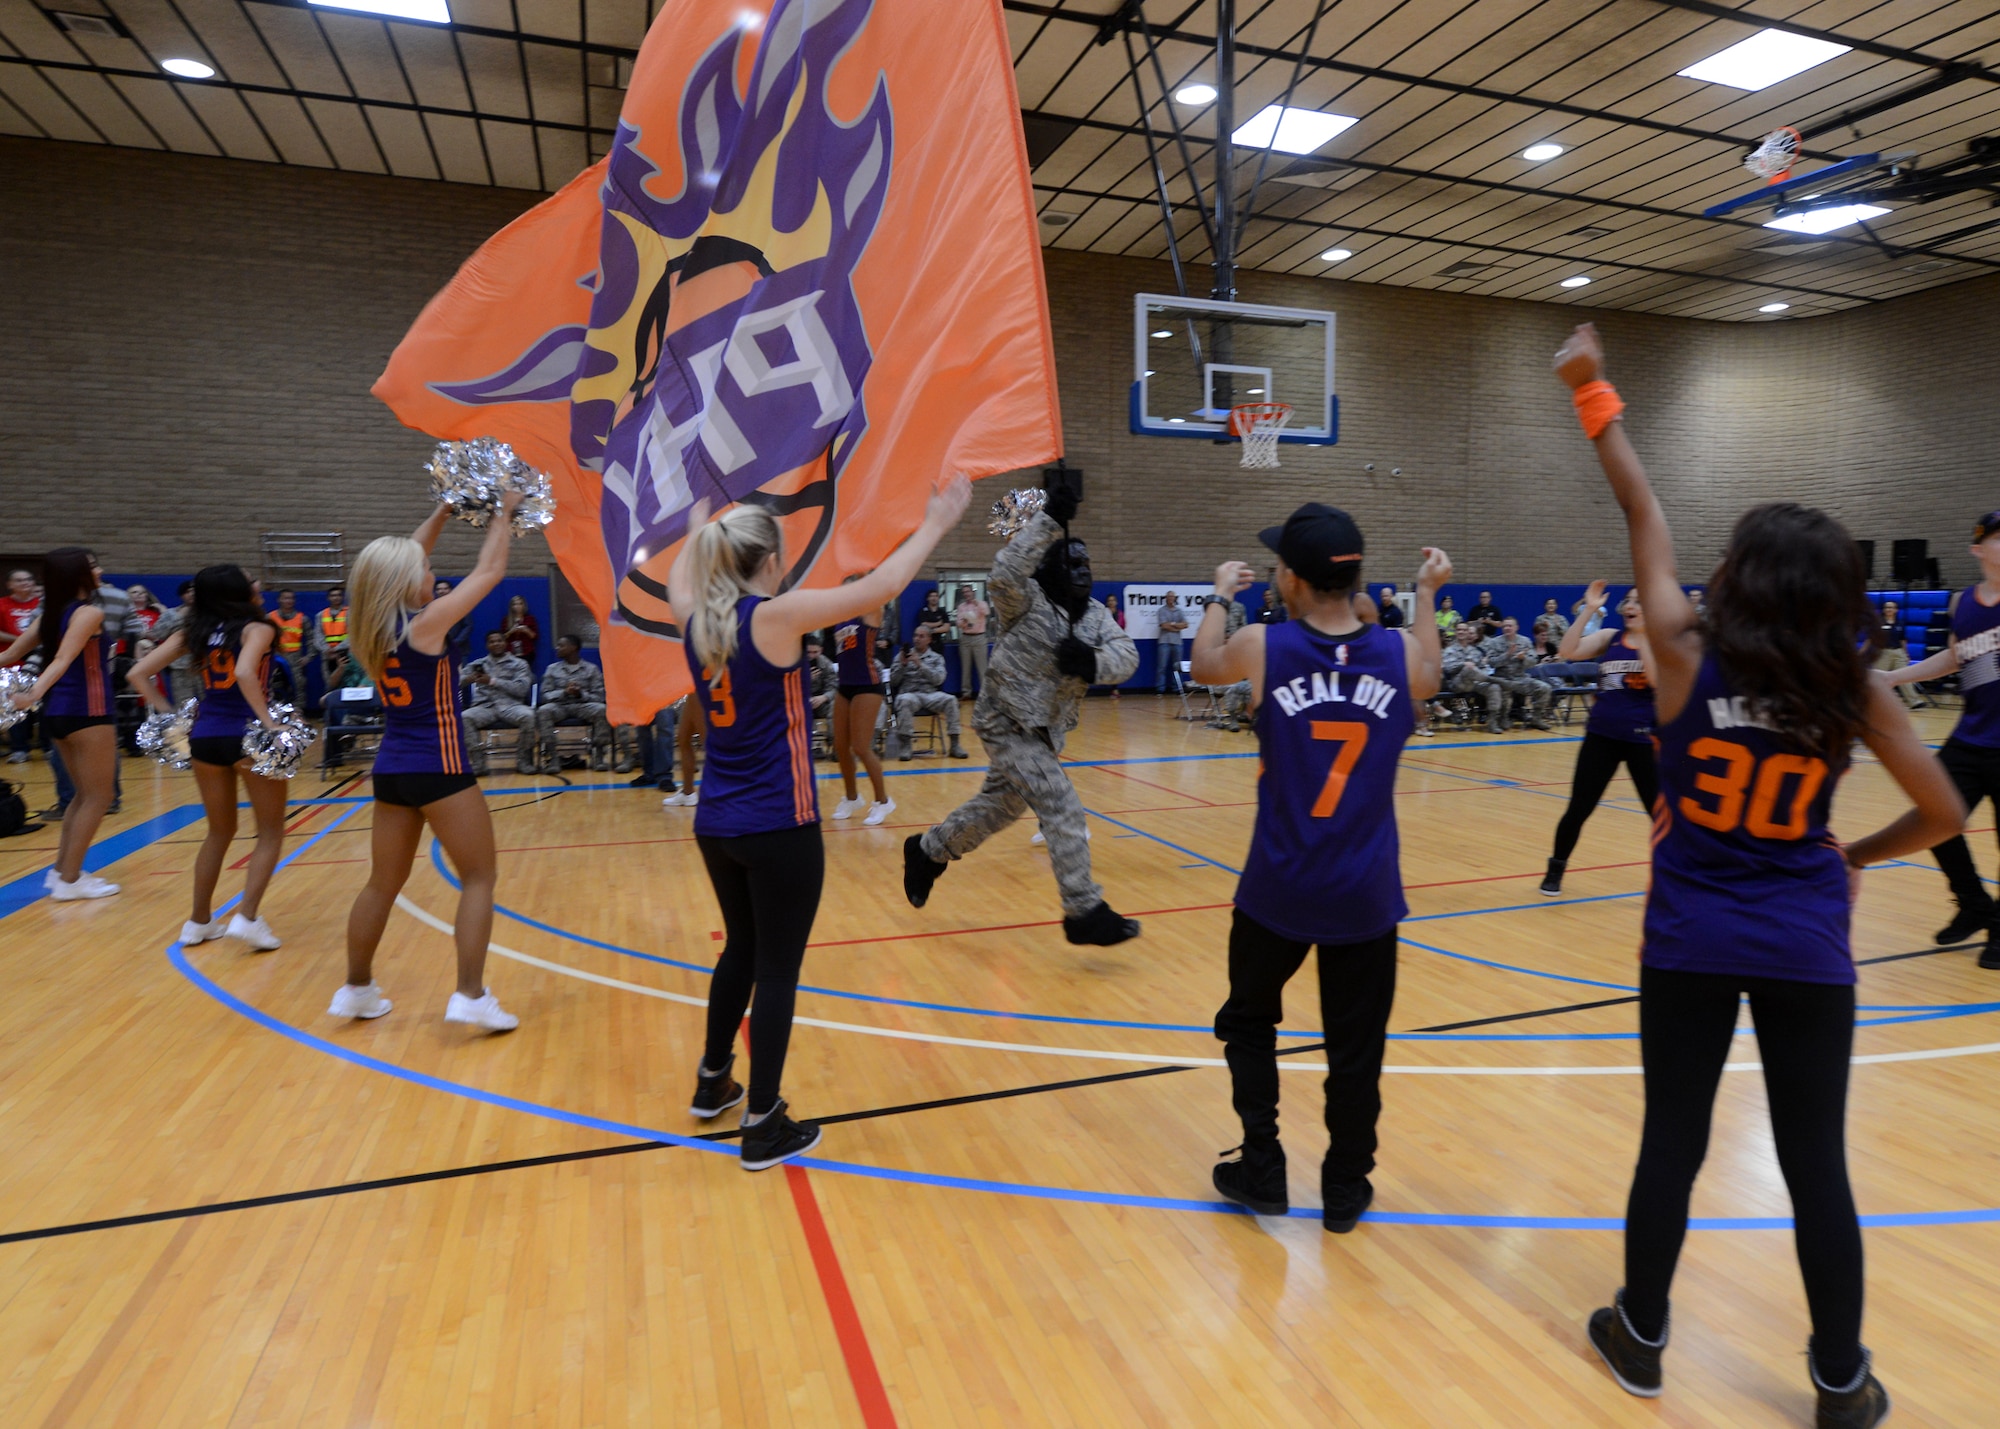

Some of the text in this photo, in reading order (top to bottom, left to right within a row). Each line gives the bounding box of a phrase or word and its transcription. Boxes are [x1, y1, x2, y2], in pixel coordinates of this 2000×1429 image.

[1185, 594, 1208, 607] yo
[702, 663, 737, 728] 3
[1271, 671, 1398, 719] REAL DYL
[1309, 720, 1370, 818] 7
[1678, 736, 1829, 841] 30
